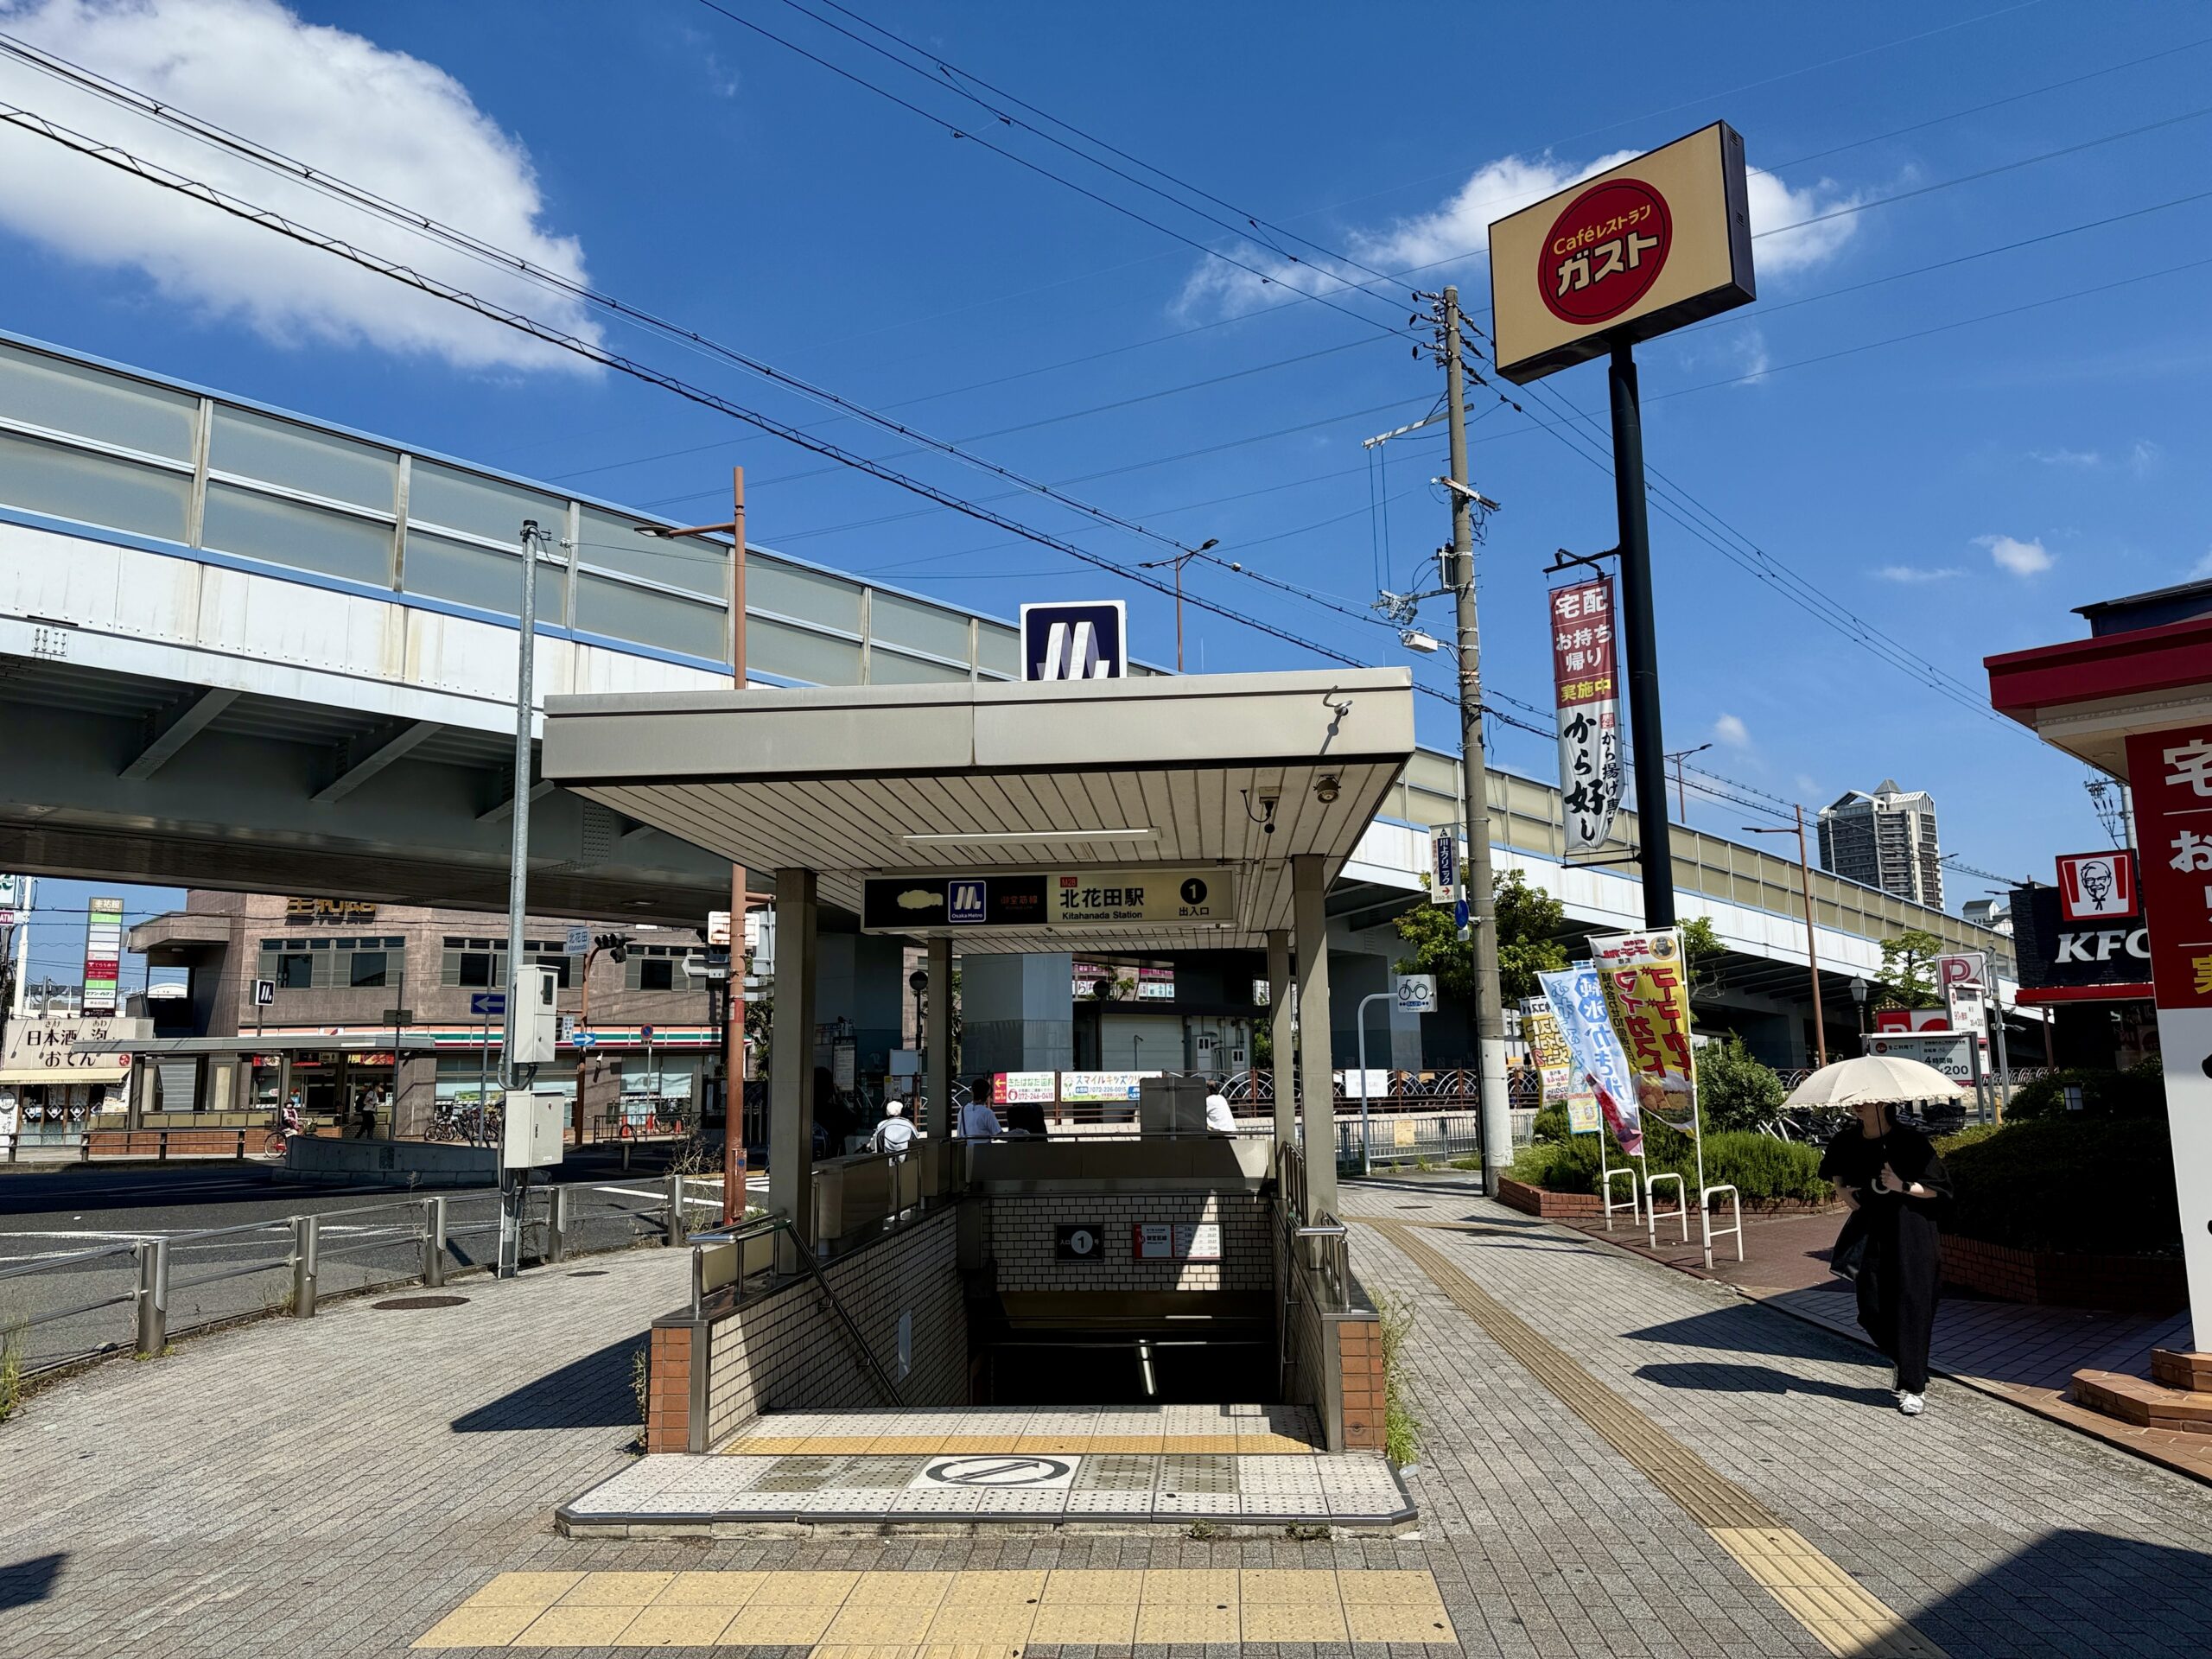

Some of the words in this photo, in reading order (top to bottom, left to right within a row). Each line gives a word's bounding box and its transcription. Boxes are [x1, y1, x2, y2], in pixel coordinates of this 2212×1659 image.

[1557, 231, 1659, 298] ガスト
[1554, 586, 1608, 619] 宅配
[1555, 622, 1612, 652] お持ち
[1565, 649, 1603, 673] 帰り
[1560, 678, 1612, 702] 実施中
[1562, 712, 1606, 842] から好し
[1440, 838, 1451, 886] 川上クリニック
[1061, 878, 1076, 887] M28
[1060, 887, 1144, 908] 北花田駅
[0, 913, 14, 923] ATM
[1062, 912, 1110, 920] Kitahanada
[1113, 911, 1142, 919] Station
[1179, 906, 1210, 917] 出入口
[2055, 929, 2152, 963] KFC
[28, 1029, 78, 1046] 日本酒
[1076, 1075, 1141, 1085] スマイルキッズクリ
